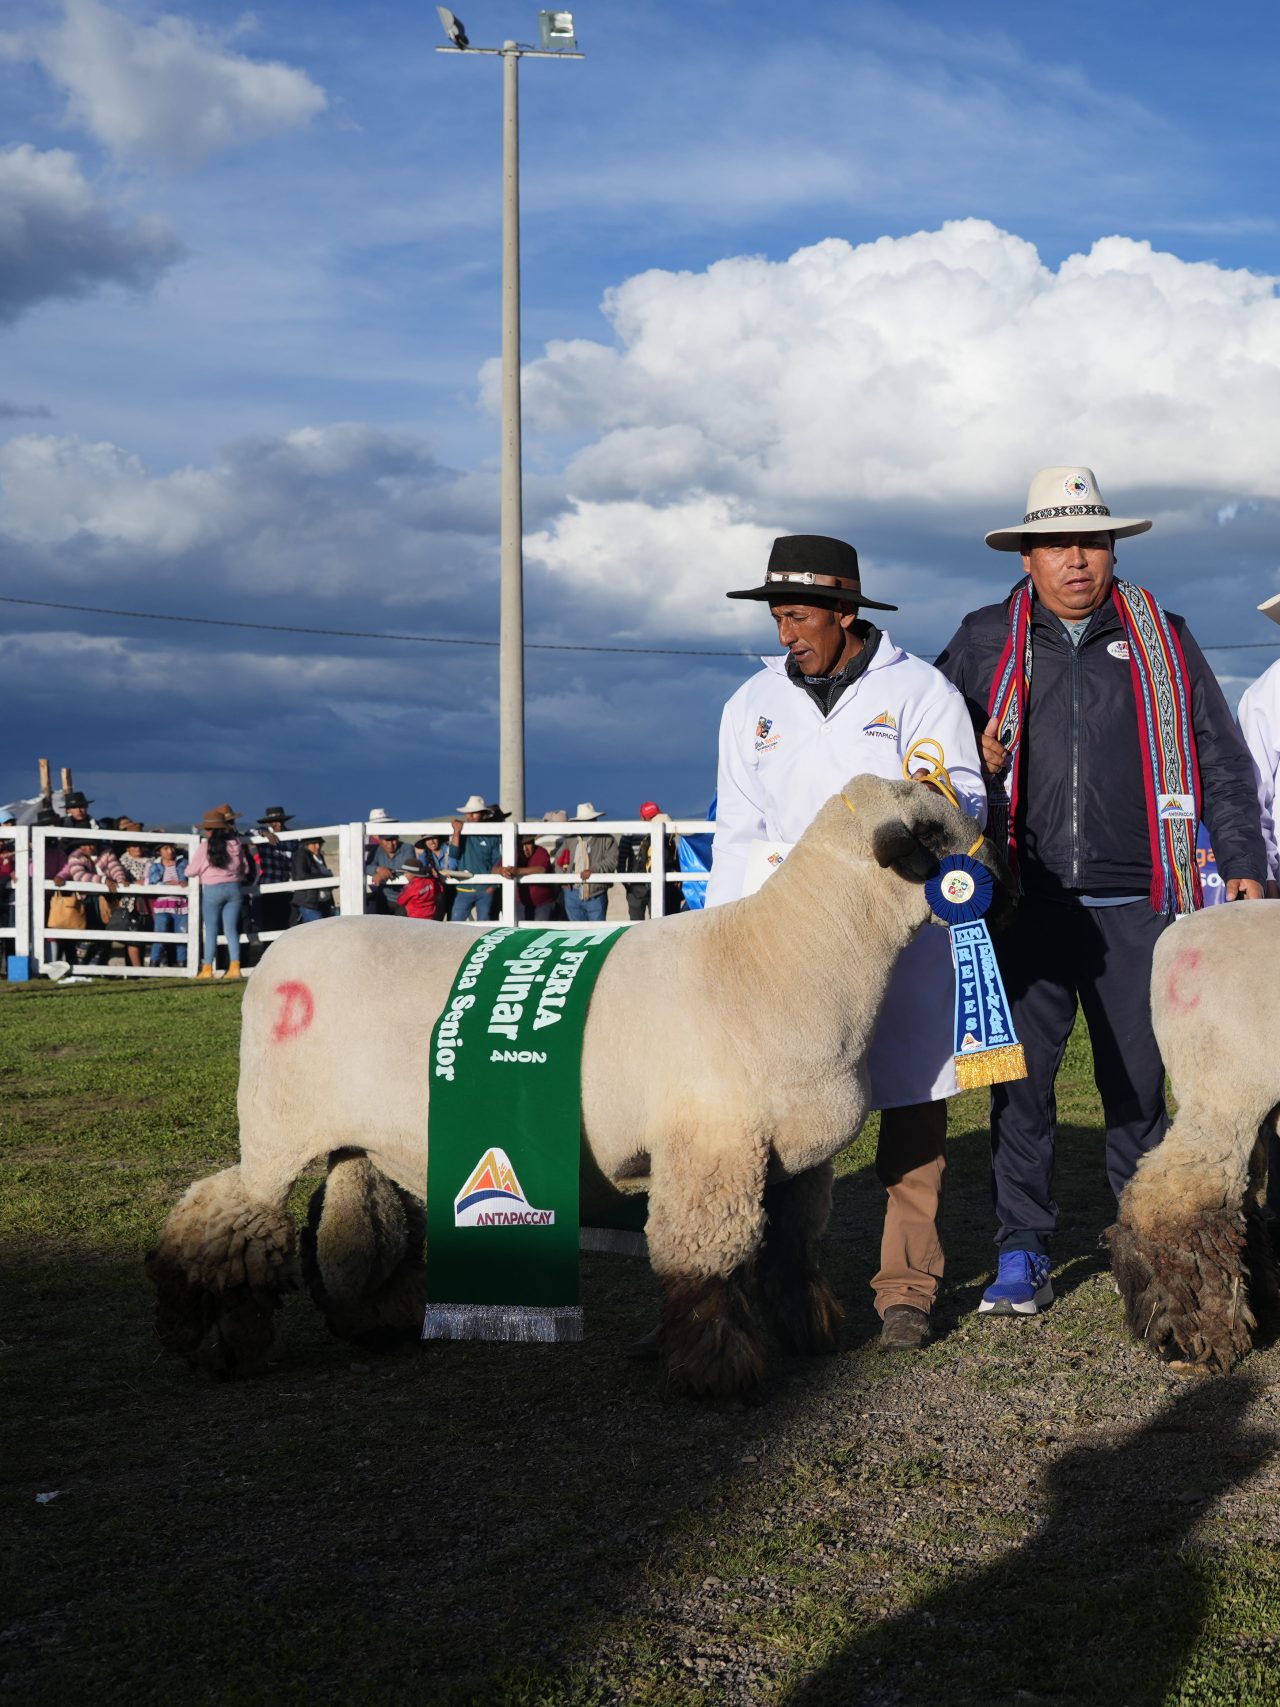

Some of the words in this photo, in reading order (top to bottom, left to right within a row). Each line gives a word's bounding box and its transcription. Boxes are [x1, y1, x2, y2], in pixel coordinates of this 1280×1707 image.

[864, 730, 899, 741] ANTAPACC
[955, 926, 983, 942] EXPO
[532, 950, 589, 1031] FERIA
[957, 947, 978, 1031] REYES
[978, 944, 1005, 1035] ESPINAR
[435, 994, 476, 1082] Senior
[988, 1033, 1009, 1044] 2024
[489, 1049, 548, 1064] 2024
[476, 1211, 552, 1226] ANTAPACCAY
